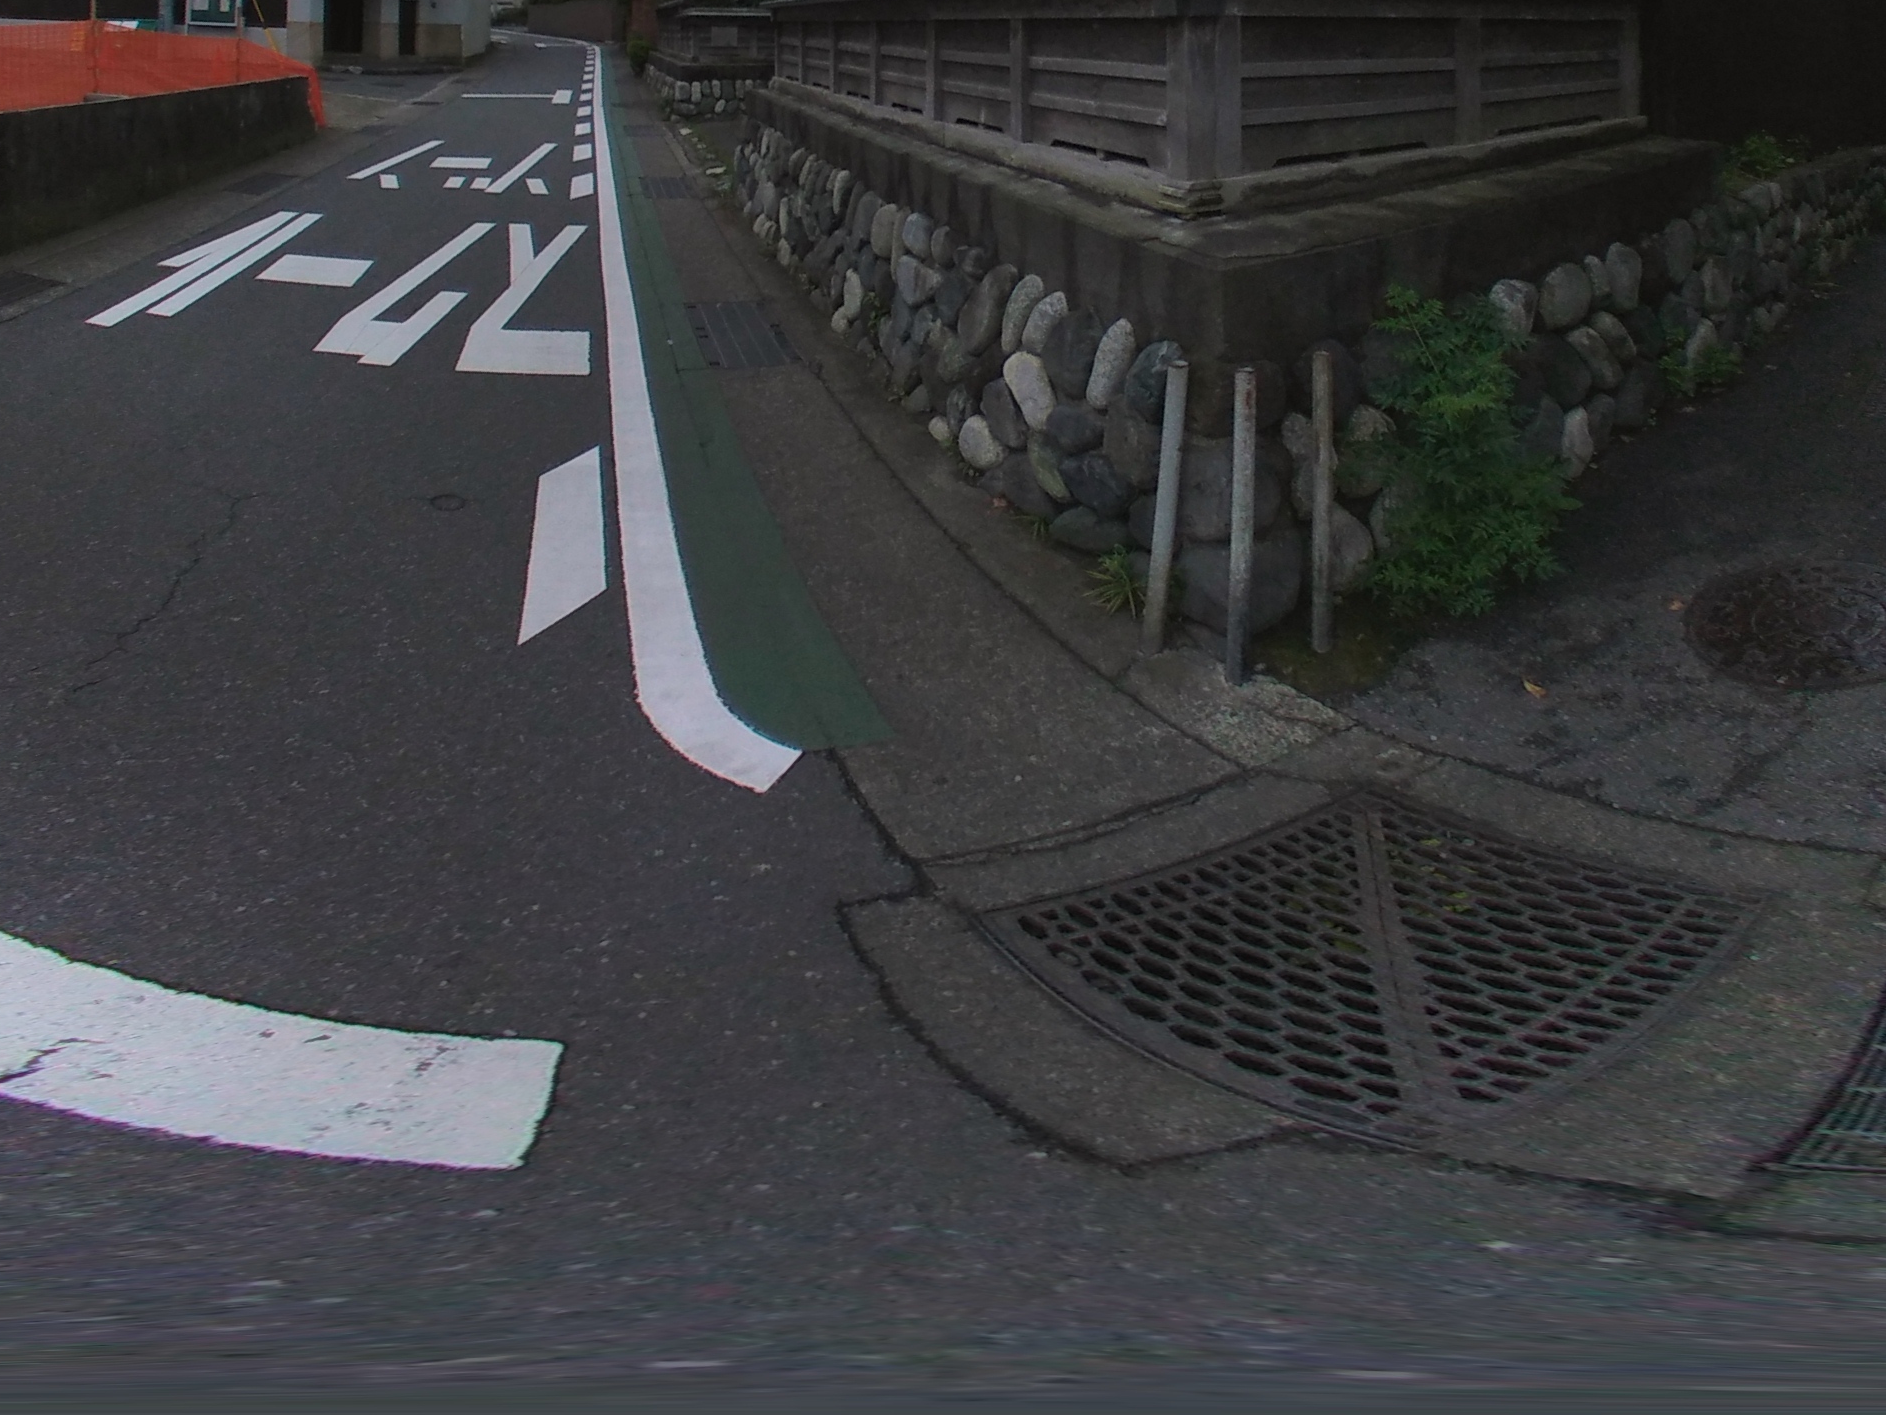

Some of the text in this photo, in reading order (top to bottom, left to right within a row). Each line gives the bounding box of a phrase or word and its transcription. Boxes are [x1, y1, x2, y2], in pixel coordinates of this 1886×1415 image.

[345, 139, 558, 195] ゾーン
[84, 211, 591, 376] スクール
